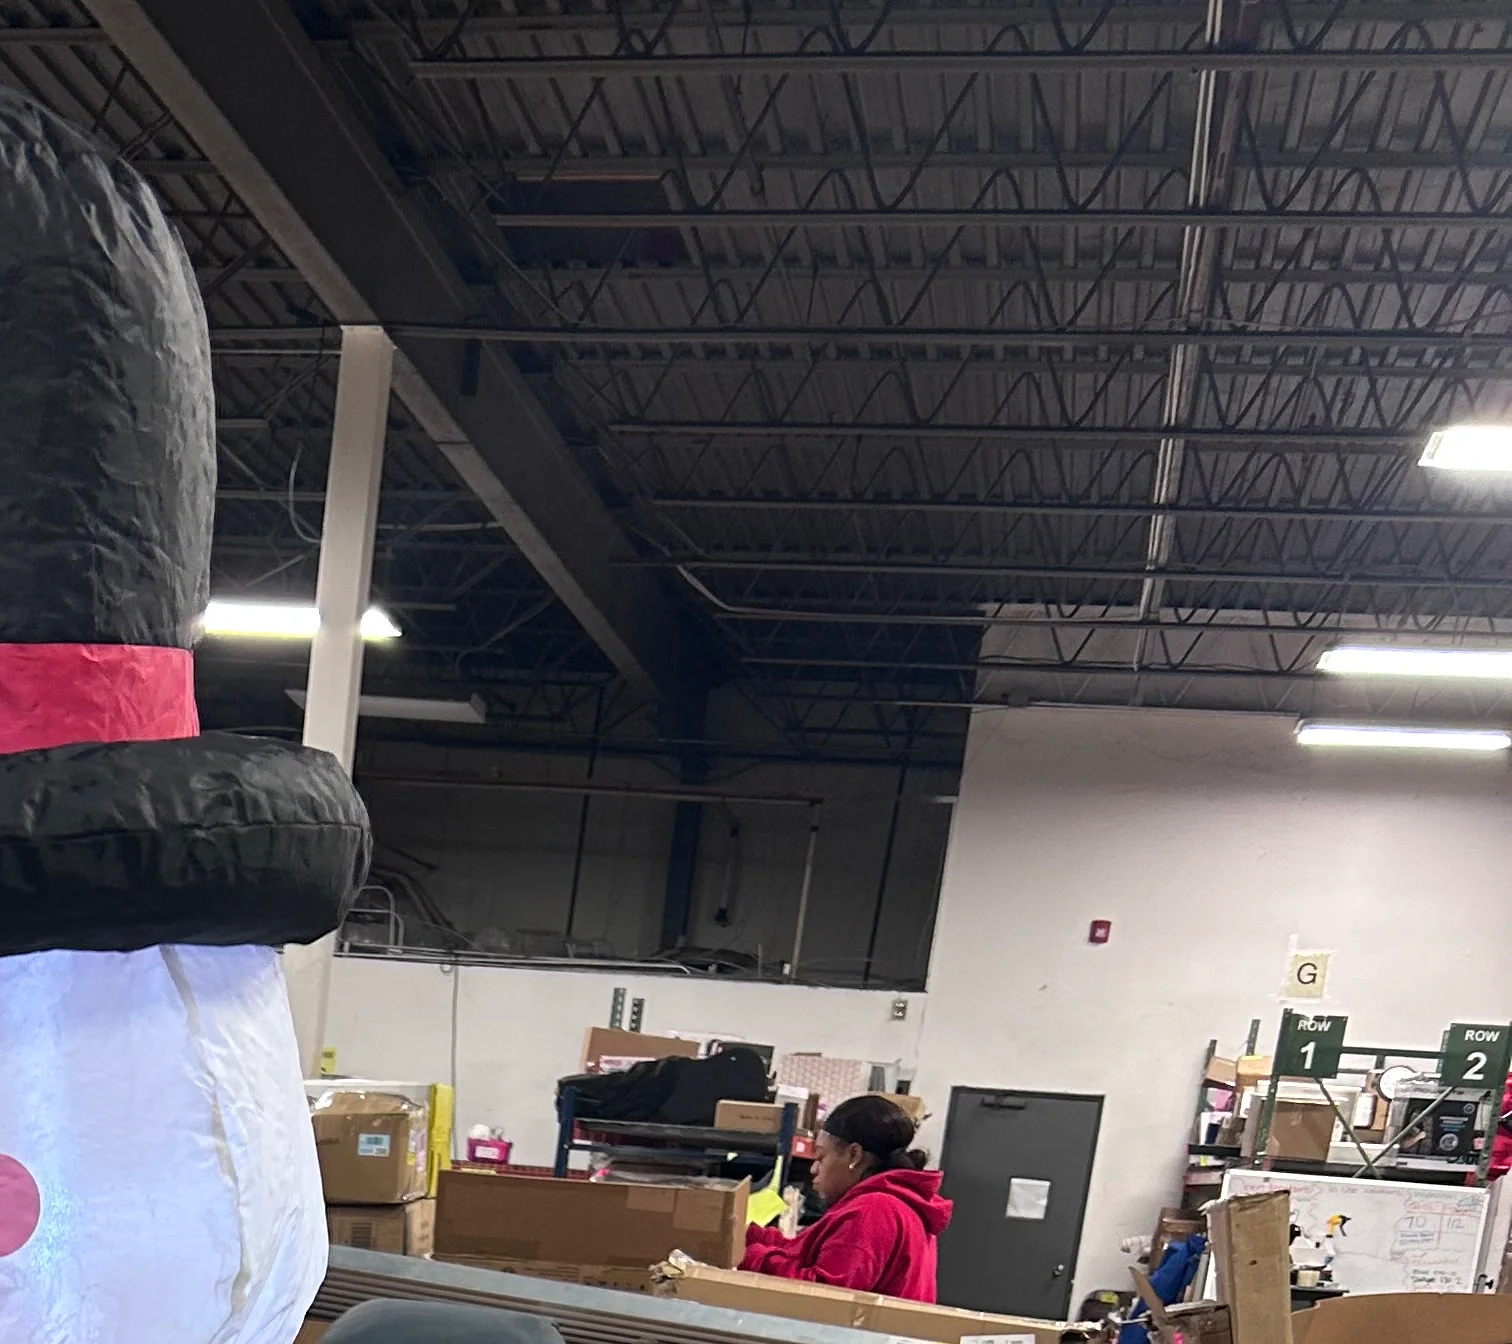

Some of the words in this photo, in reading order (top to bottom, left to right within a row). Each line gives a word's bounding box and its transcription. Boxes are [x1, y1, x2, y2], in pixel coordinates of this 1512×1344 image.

[1297, 963, 1318, 985] G
[1297, 1019, 1331, 1032] ROW
[1464, 1029, 1500, 1042] ROW
[1300, 1041, 1316, 1070] 1
[1462, 1052, 1487, 1080] 2
